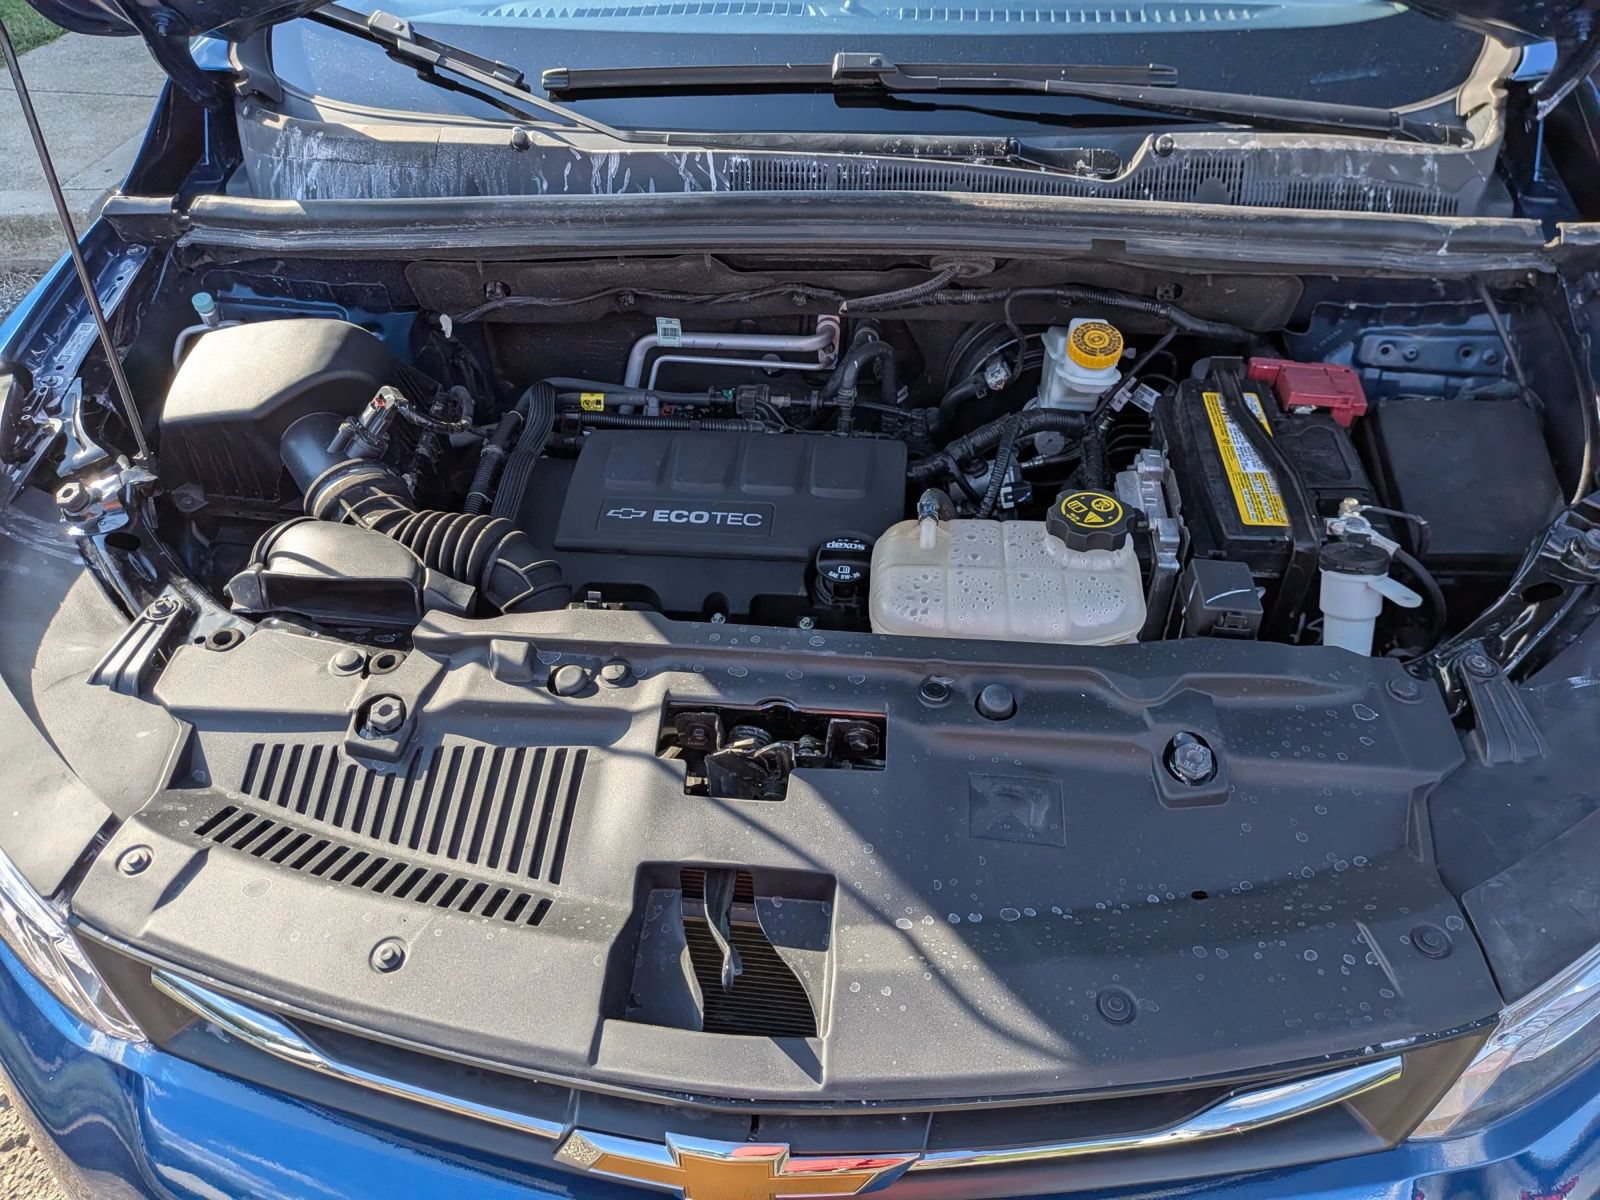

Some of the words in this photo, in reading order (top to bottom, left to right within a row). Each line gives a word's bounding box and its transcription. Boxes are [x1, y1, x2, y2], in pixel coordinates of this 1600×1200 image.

[652, 509, 763, 526] ECOTEC
[826, 541, 865, 551] dexos
[828, 571, 840, 579] SAE
